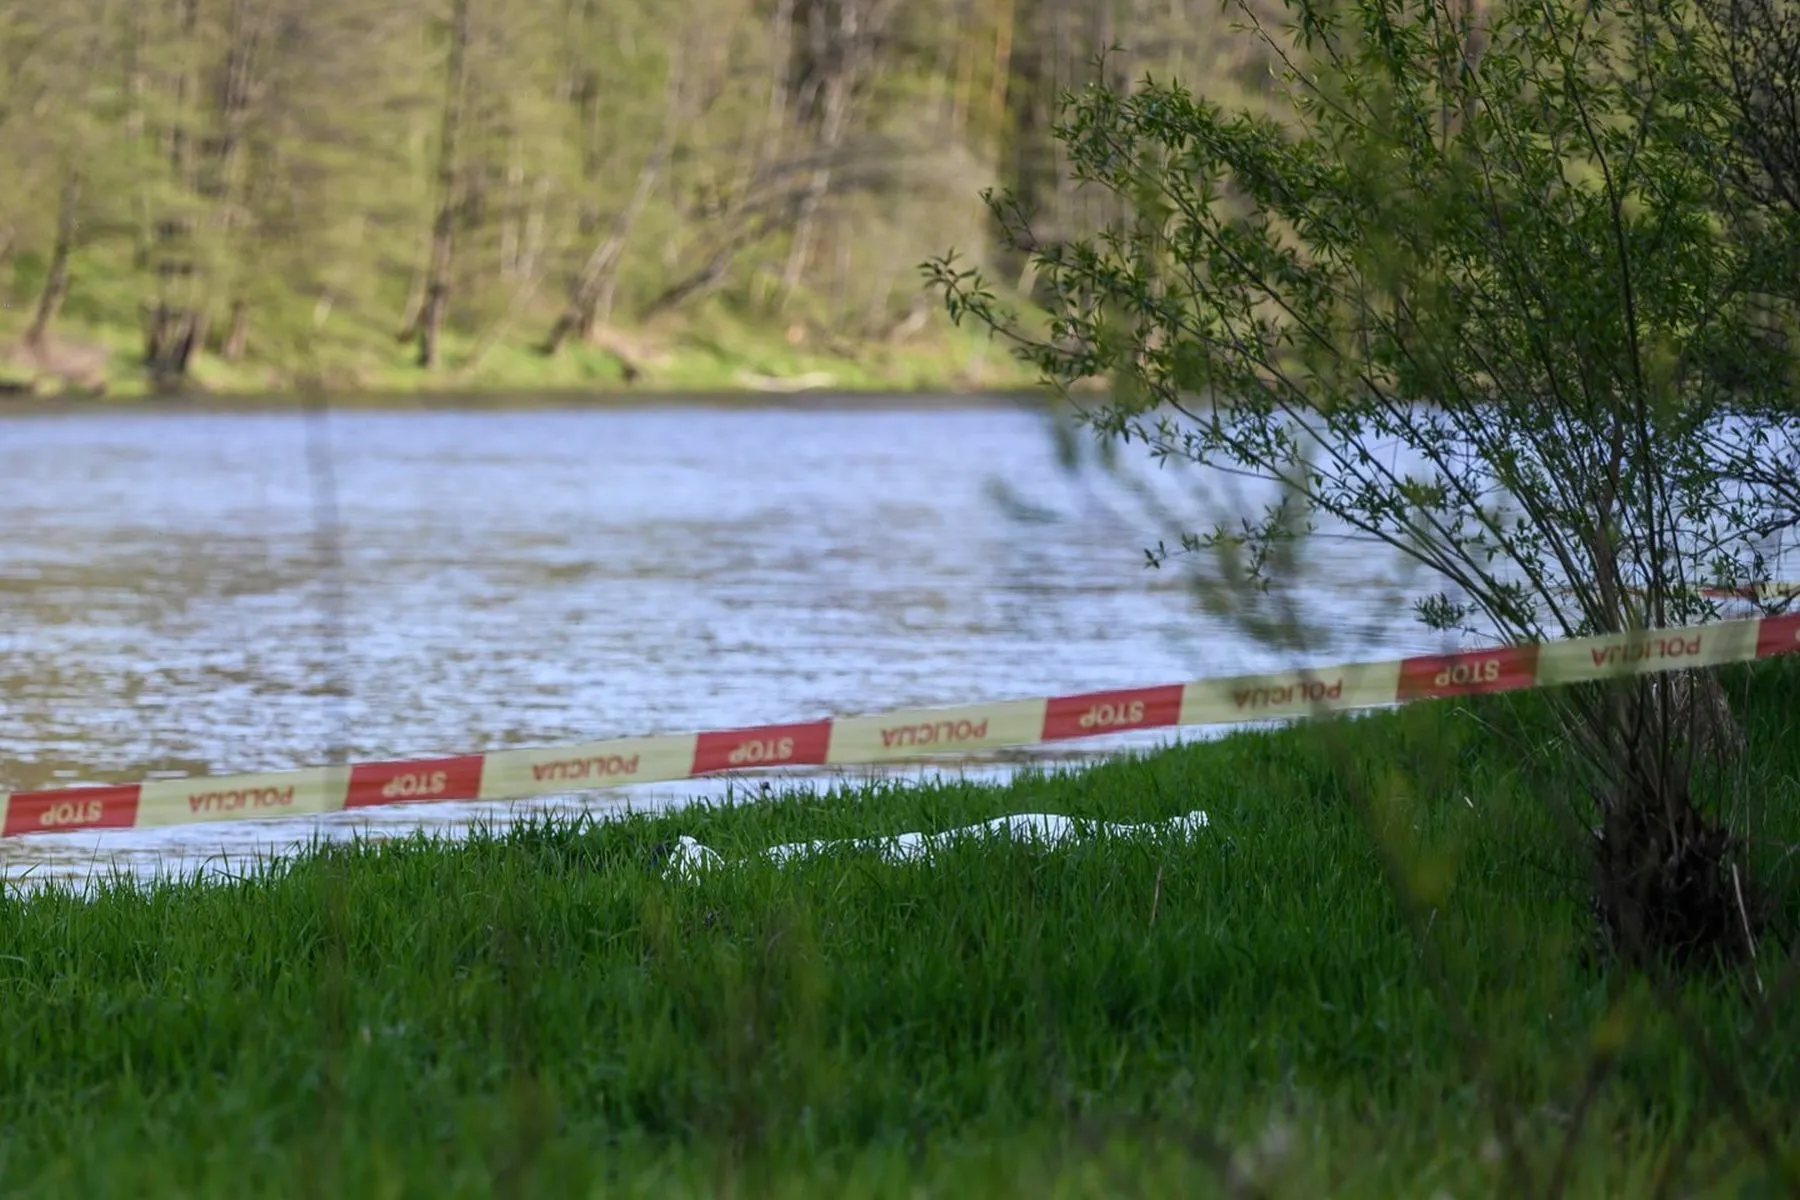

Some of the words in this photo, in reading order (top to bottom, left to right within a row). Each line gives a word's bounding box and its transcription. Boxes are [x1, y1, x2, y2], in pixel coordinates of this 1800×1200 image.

[1591, 634, 1702, 666] POLICIJA
[1435, 660, 1500, 686] STOP
[1233, 679, 1342, 711] POLICIJA
[1079, 701, 1144, 727] STOP
[881, 717, 988, 747] POLICIJA
[729, 737, 794, 763] STOP
[532, 754, 639, 781] POLICIJA
[382, 771, 447, 797] STOP
[188, 786, 295, 813] POLICIJA
[40, 801, 102, 826] STOP
